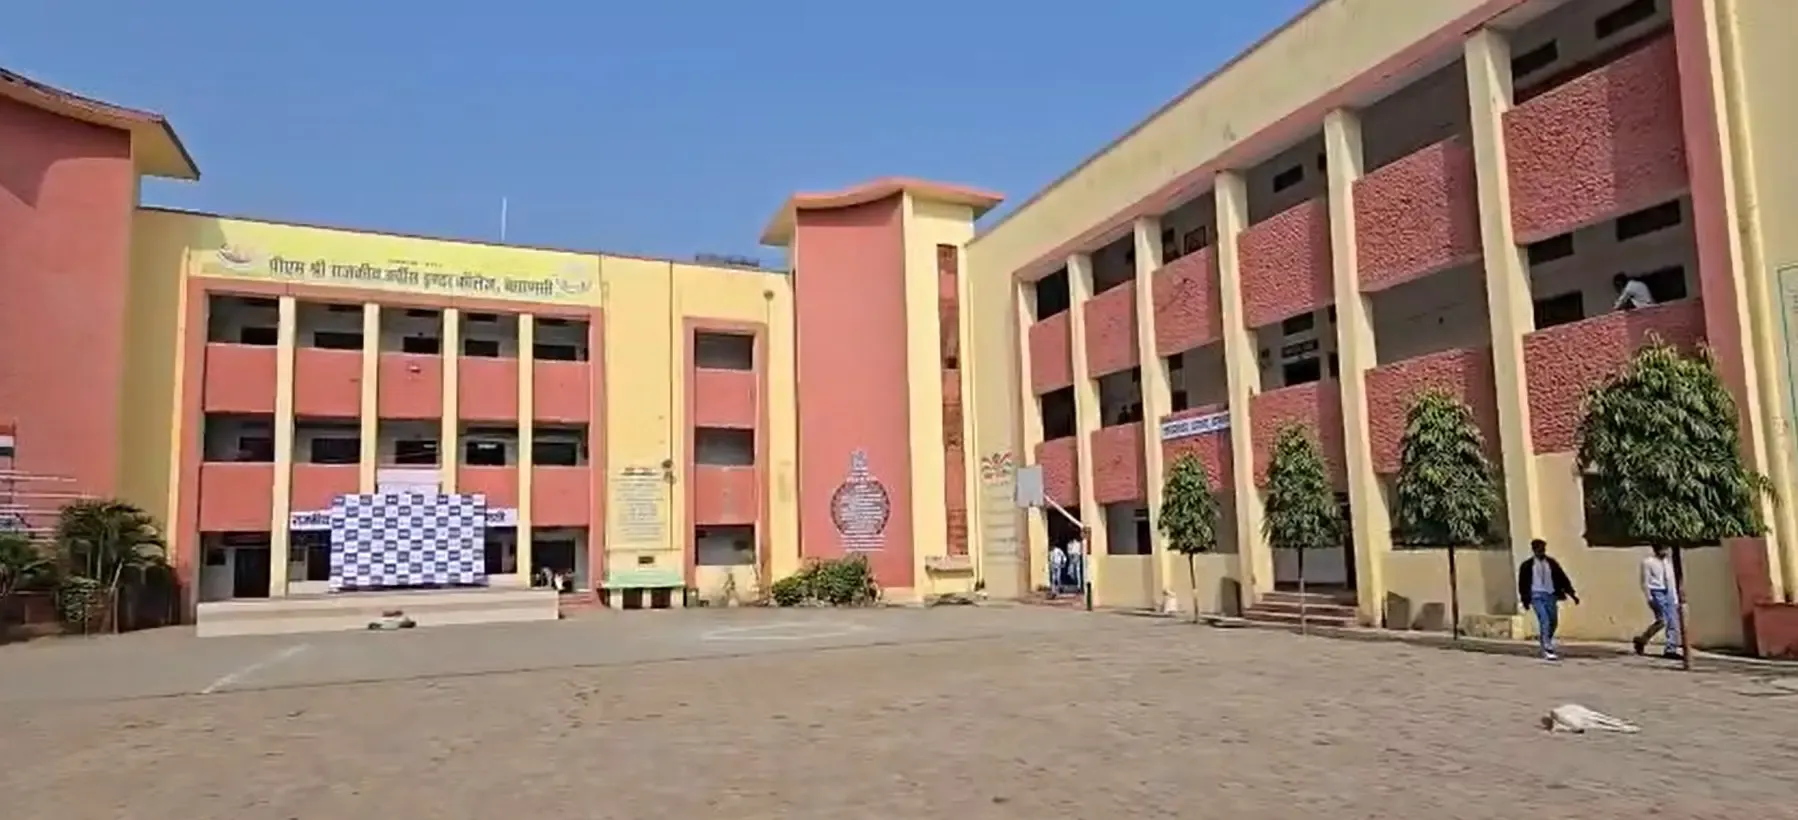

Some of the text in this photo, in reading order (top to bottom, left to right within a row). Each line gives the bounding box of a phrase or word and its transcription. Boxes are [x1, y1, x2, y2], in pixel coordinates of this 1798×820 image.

[269, 256, 305, 275] पीएम
[310, 259, 326, 278] श्री
[331, 262, 383, 280] राजकीय
